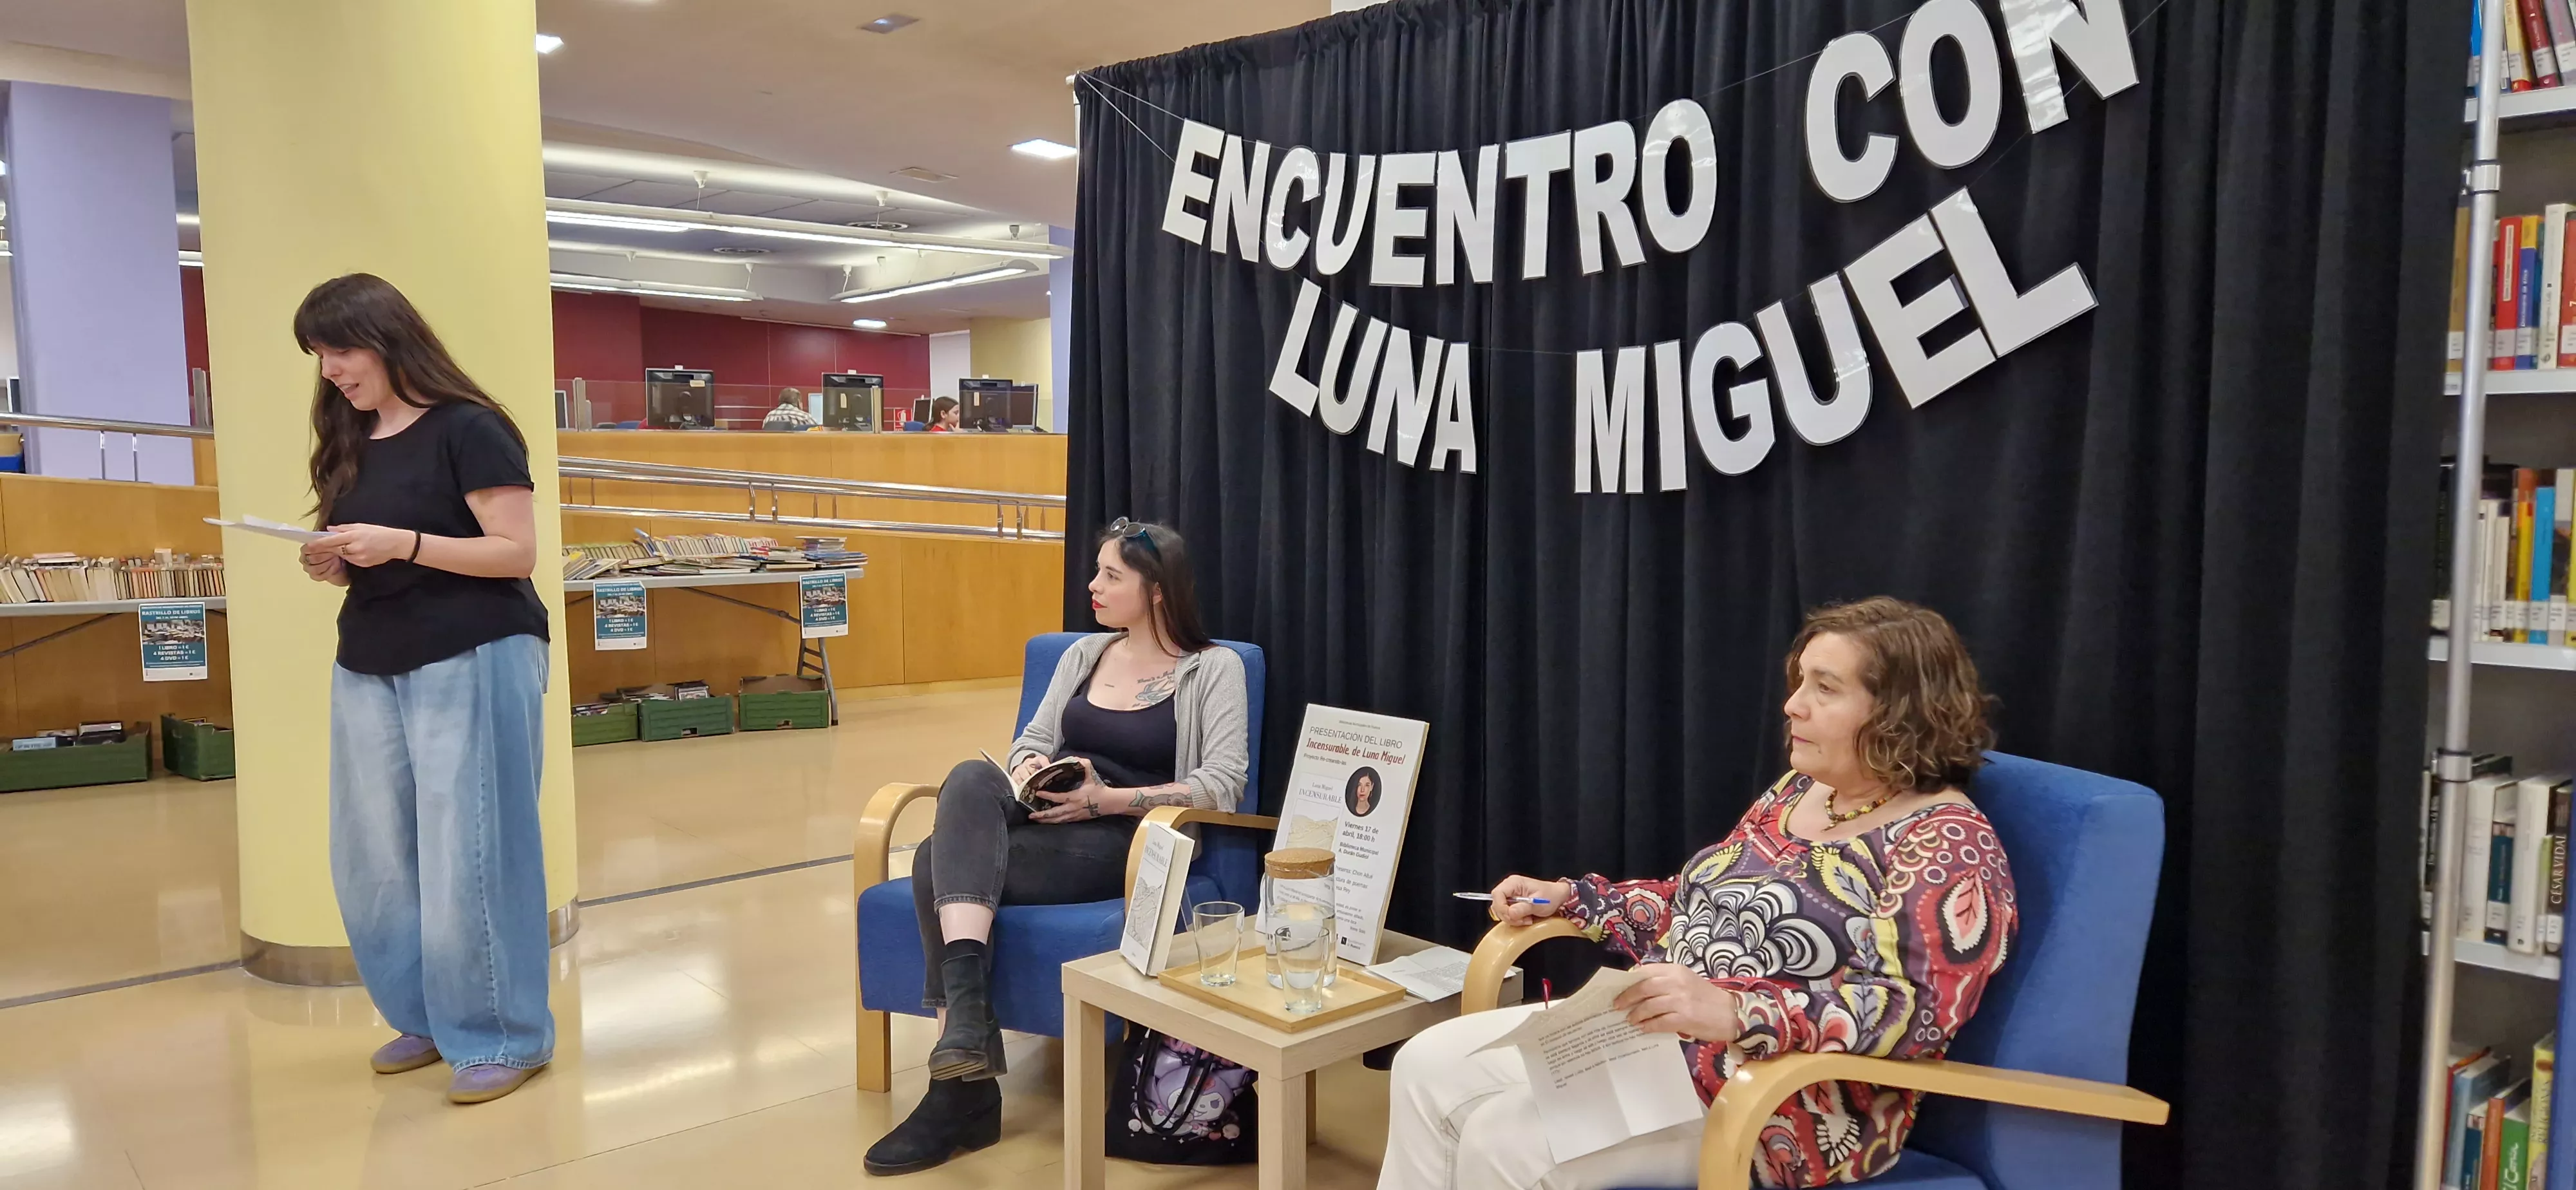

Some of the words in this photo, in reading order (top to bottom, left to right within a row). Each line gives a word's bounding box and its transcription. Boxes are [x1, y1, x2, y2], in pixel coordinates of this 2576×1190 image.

[1162, 98, 1717, 287] ENCUENTRO
[1806, 0, 2139, 203] CON
[1269, 277, 1477, 474] LUNA
[1574, 185, 2099, 495] MIGUEL
[1310, 726, 1363, 742] PRESENTACIÓN
[1364, 736, 1377, 745] DEL
[1380, 738, 1402, 749] LIBRO
[1352, 746, 1361, 756] de
[1362, 748, 1380, 760] Luna
[1381, 751, 1406, 765] Miguel
[1299, 789, 1342, 803] INCENSURABLE
[1342, 830, 1355, 839] abril,
[1345, 821, 1363, 830] Viernes
[1340, 842, 1359, 850] Biblioteca
[1360, 846, 1379, 855] Municipal
[2553, 835, 2566, 867] VIDAL
[2550, 870, 2564, 904] CÉSAR
